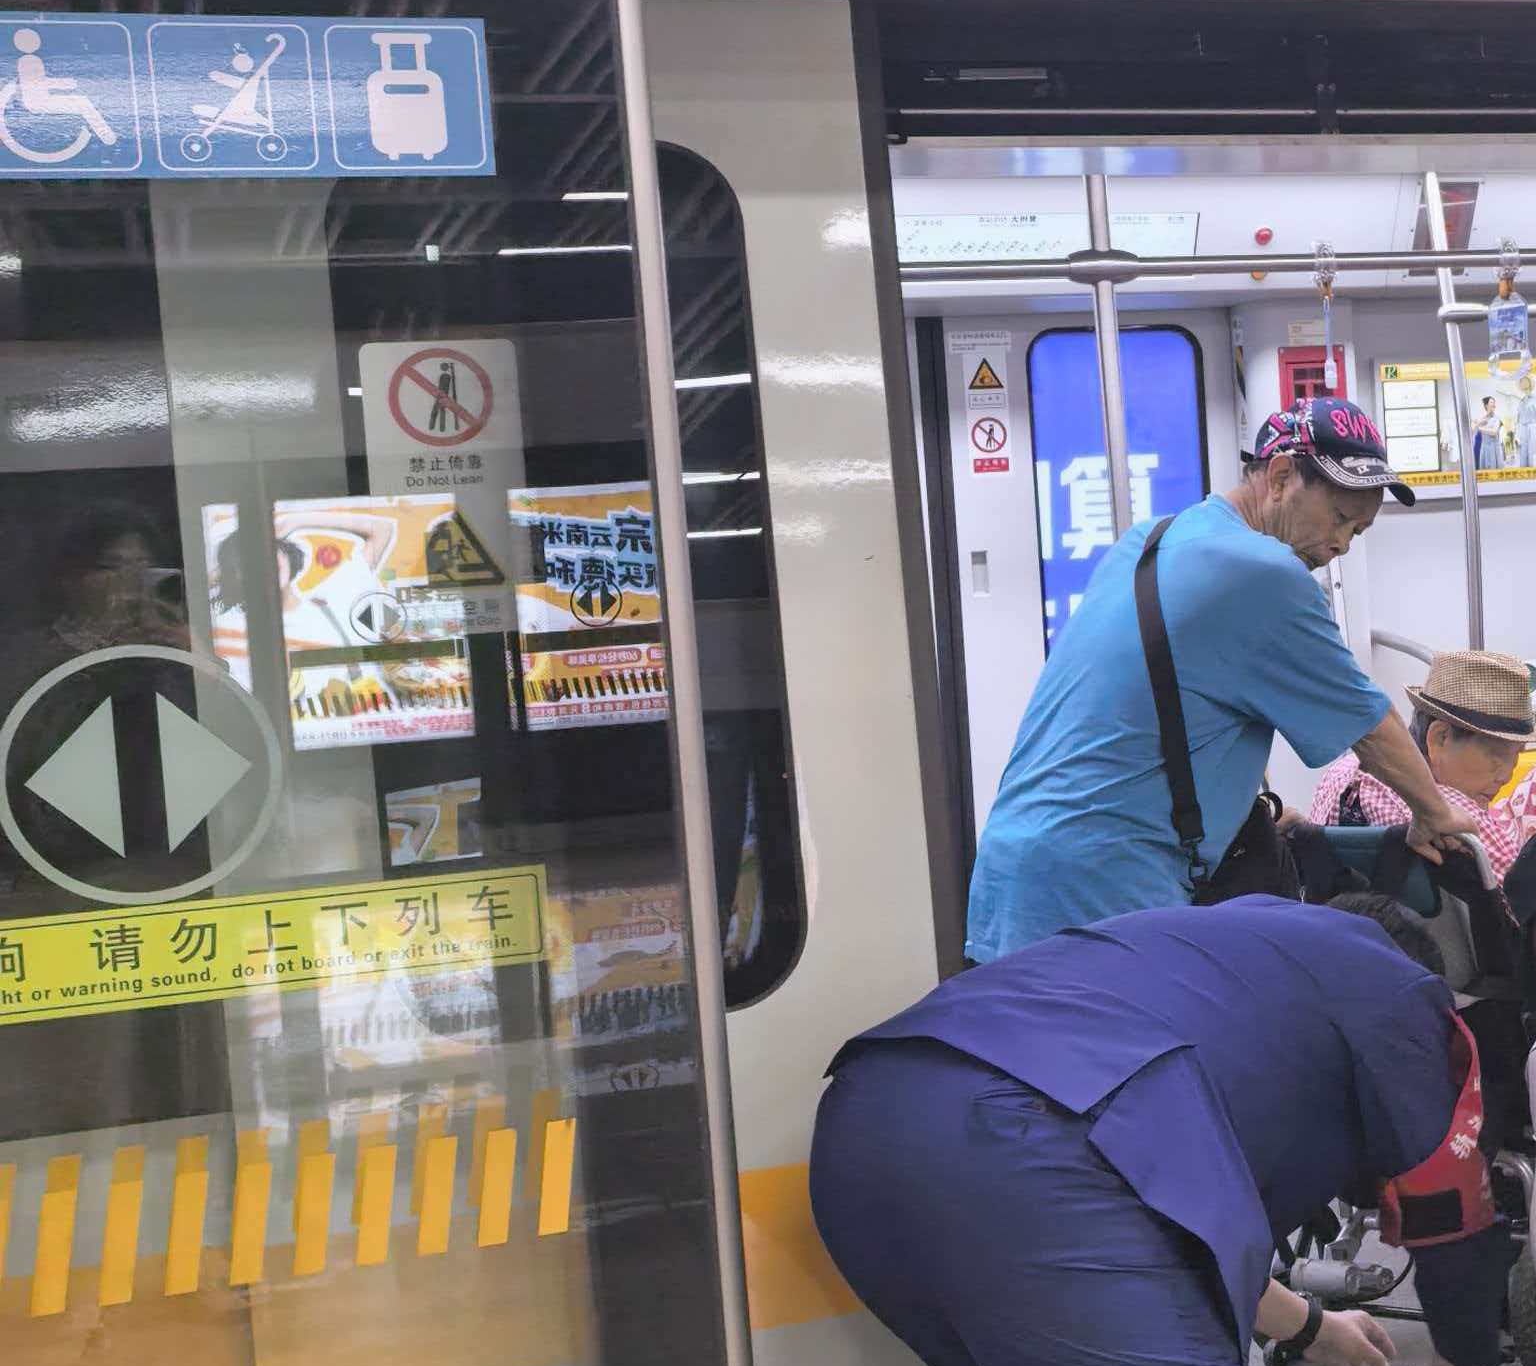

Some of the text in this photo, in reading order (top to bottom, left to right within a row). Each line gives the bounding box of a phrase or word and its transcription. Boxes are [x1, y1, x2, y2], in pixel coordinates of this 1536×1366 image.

[406, 473, 484, 487] Do Not Lean
[409, 454, 482, 473] 禁止倚靠
[1036, 453, 1159, 560] 算
[90, 885, 513, 972] 请勿上下列车
[31, 988, 51, 1001] or
[60, 977, 143, 1000] warning
[151, 968, 217, 987] sound,
[232, 963, 255, 978] do
[263, 959, 293, 975] not
[301, 950, 357, 970] board
[363, 950, 383, 963] or
[390, 944, 425, 961] exit
[432, 940, 461, 955] the
